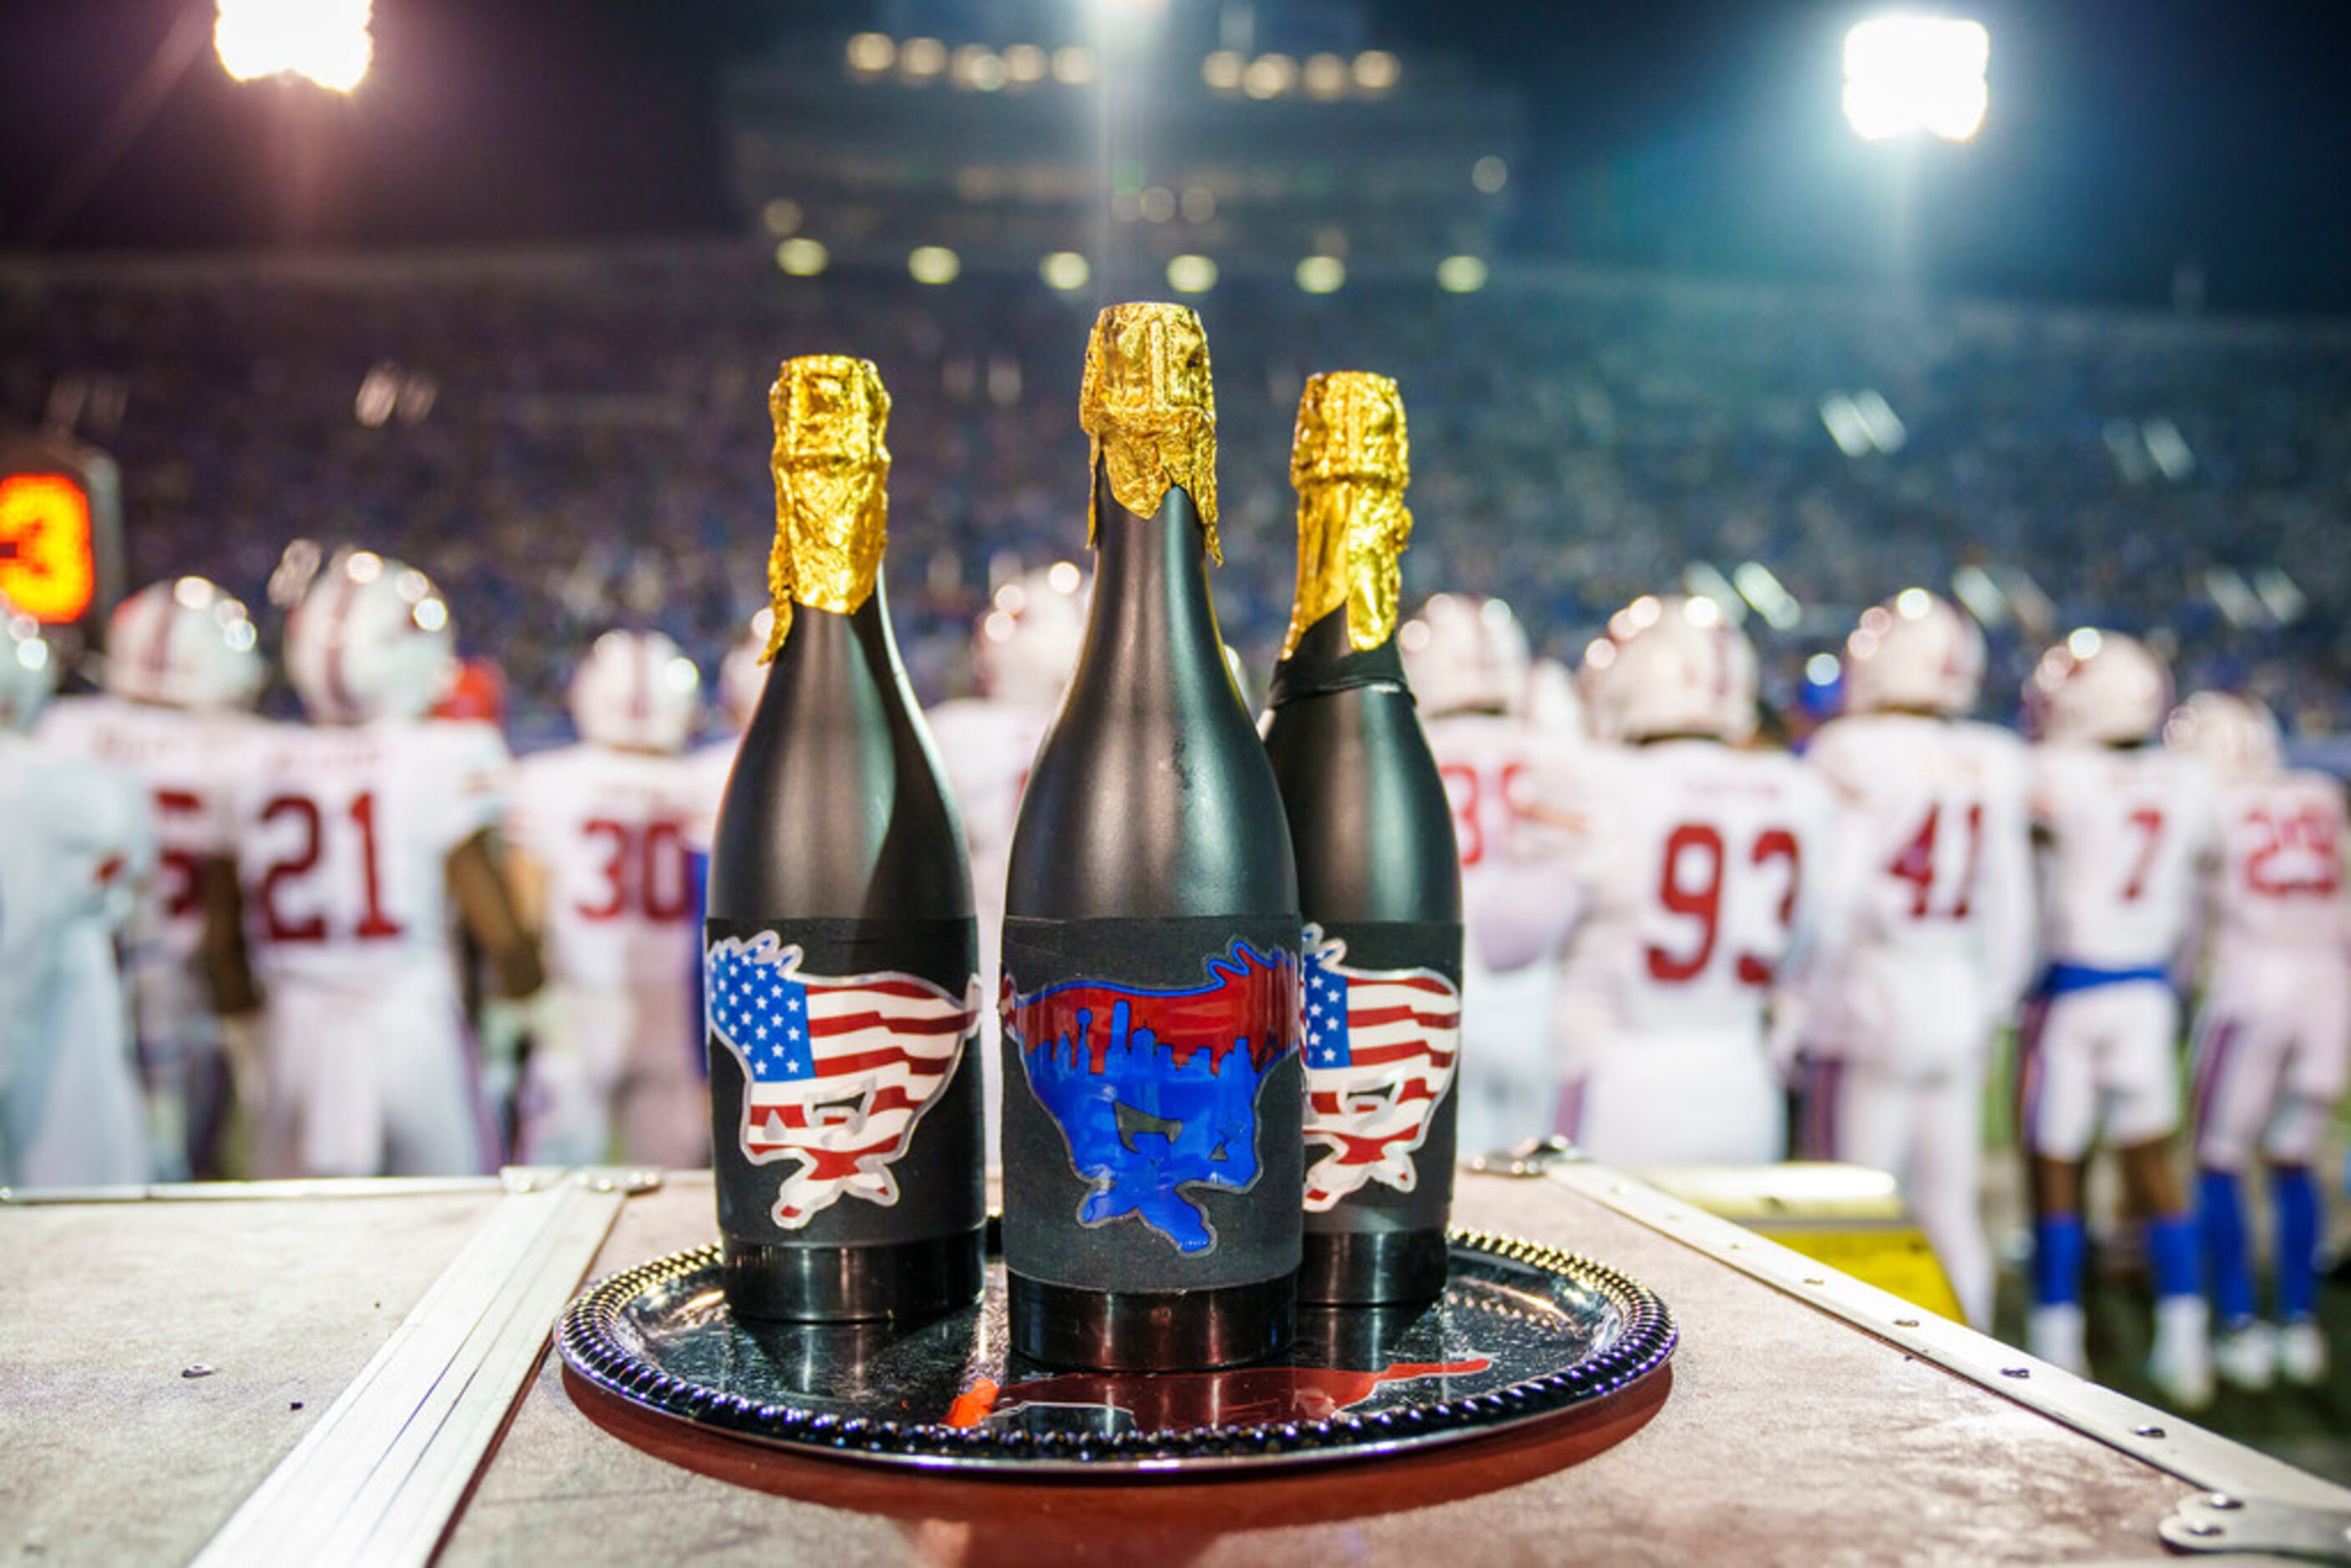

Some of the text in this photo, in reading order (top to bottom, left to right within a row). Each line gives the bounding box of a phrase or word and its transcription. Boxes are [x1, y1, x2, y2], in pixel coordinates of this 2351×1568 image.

[259, 792, 399, 943] 21
[576, 819, 695, 923] 30
[1642, 822, 1802, 987] 93
[1888, 803, 1984, 920] 41
[2125, 808, 2164, 902] 7
